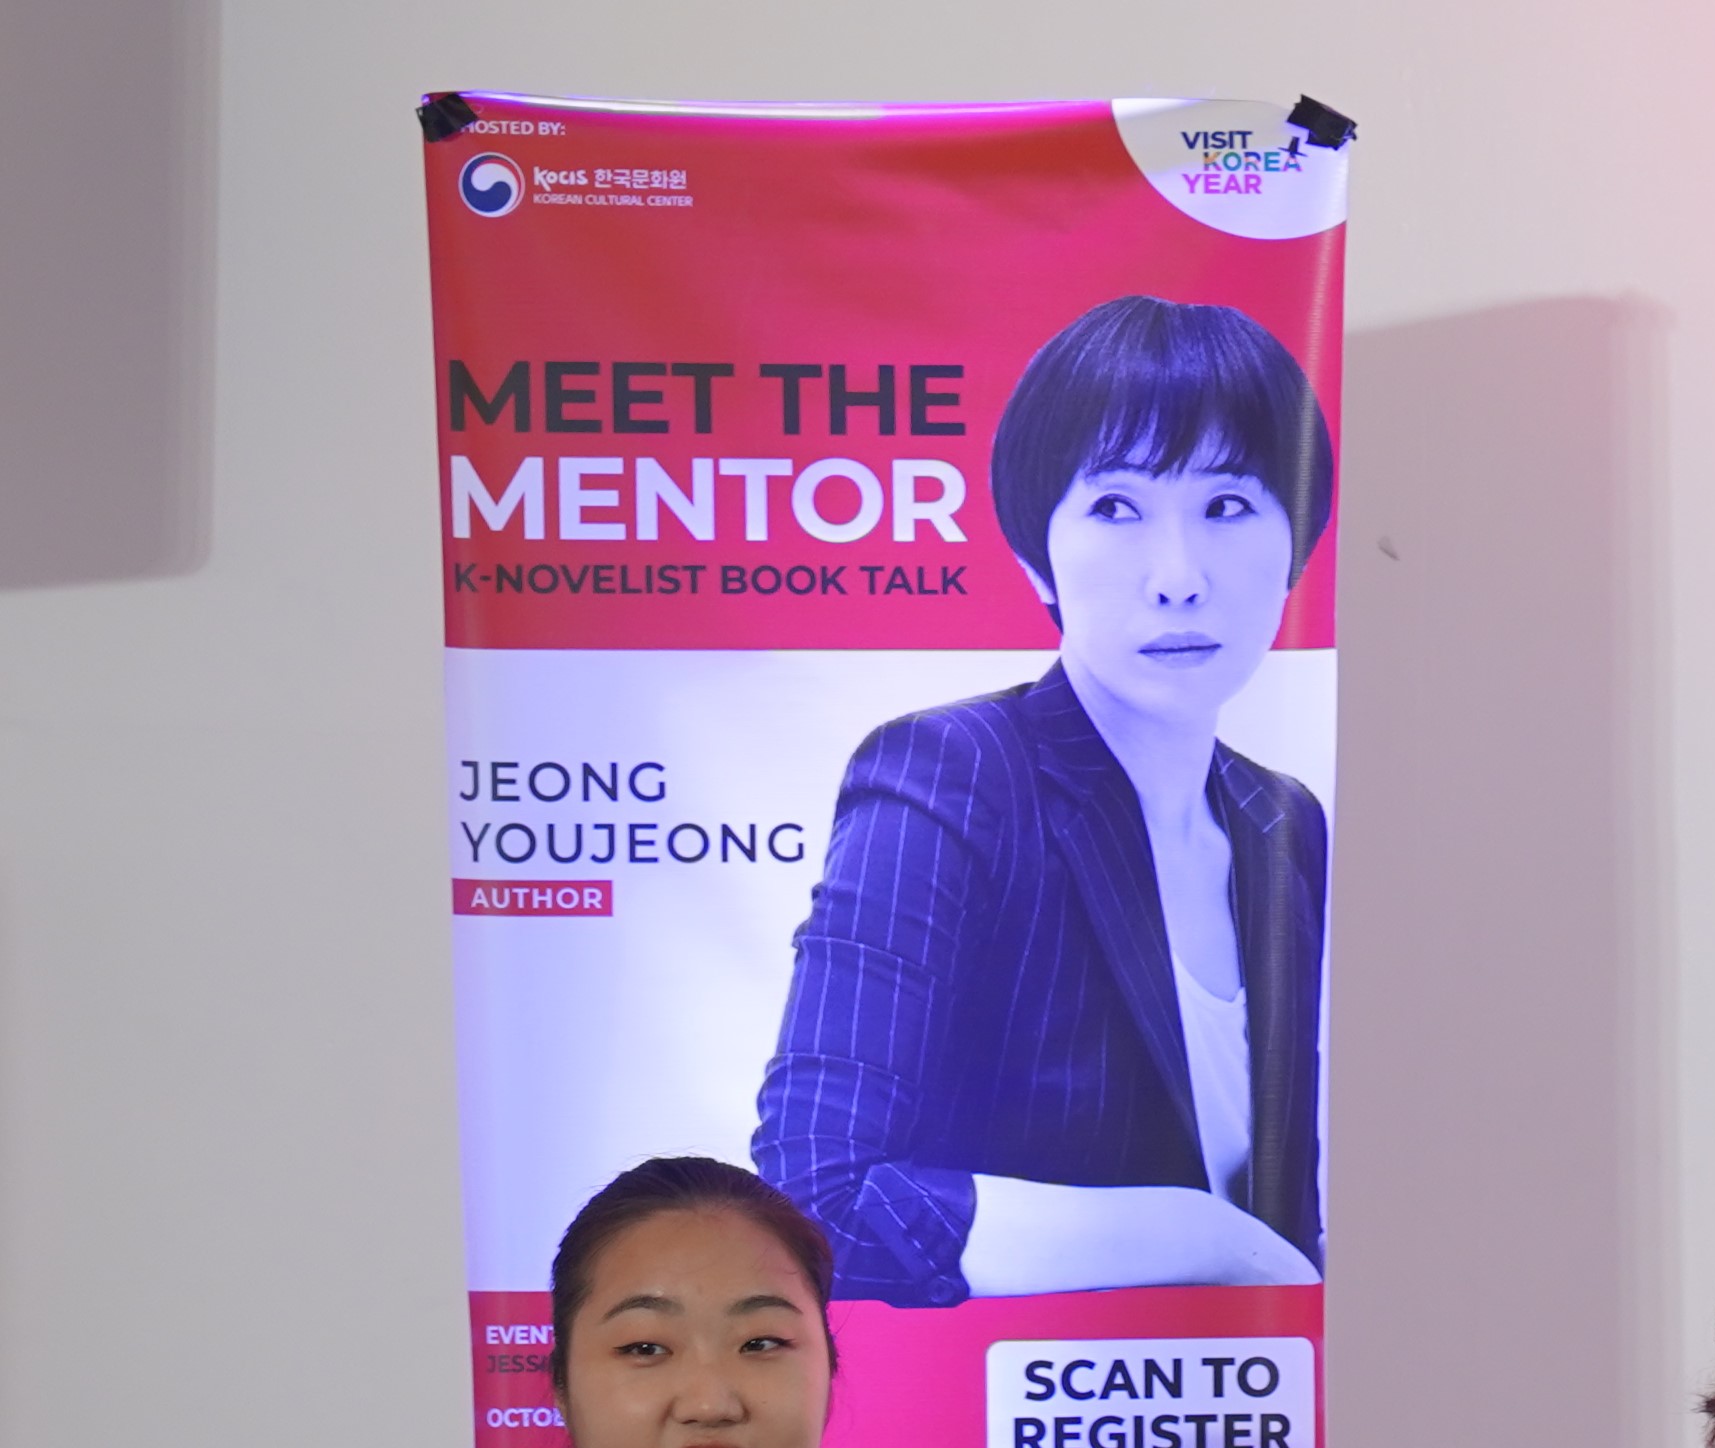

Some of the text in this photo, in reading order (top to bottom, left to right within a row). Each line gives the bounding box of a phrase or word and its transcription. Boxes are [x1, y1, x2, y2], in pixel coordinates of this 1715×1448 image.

[538, 121, 566, 136] BY:
[1181, 131, 1253, 149] VISIT
[1203, 151, 1302, 172] KOREA
[594, 169, 687, 189] 한국문화원
[1182, 173, 1262, 194] YEAR
[533, 193, 693, 207] KOREAN CULTURAL CENTER
[448, 359, 966, 436] MEET THE
[450, 455, 968, 543] MENTOR
[453, 563, 968, 596] K-NOVELIST BOOK TALK
[460, 760, 666, 802] JEONG
[461, 821, 805, 863] YOUJEONG
[470, 887, 603, 910] AUTHOR
[486, 1355, 552, 1374] JESS
[1024, 1356, 1279, 1401] SCAN TO
[486, 1408, 567, 1428] OCTO
